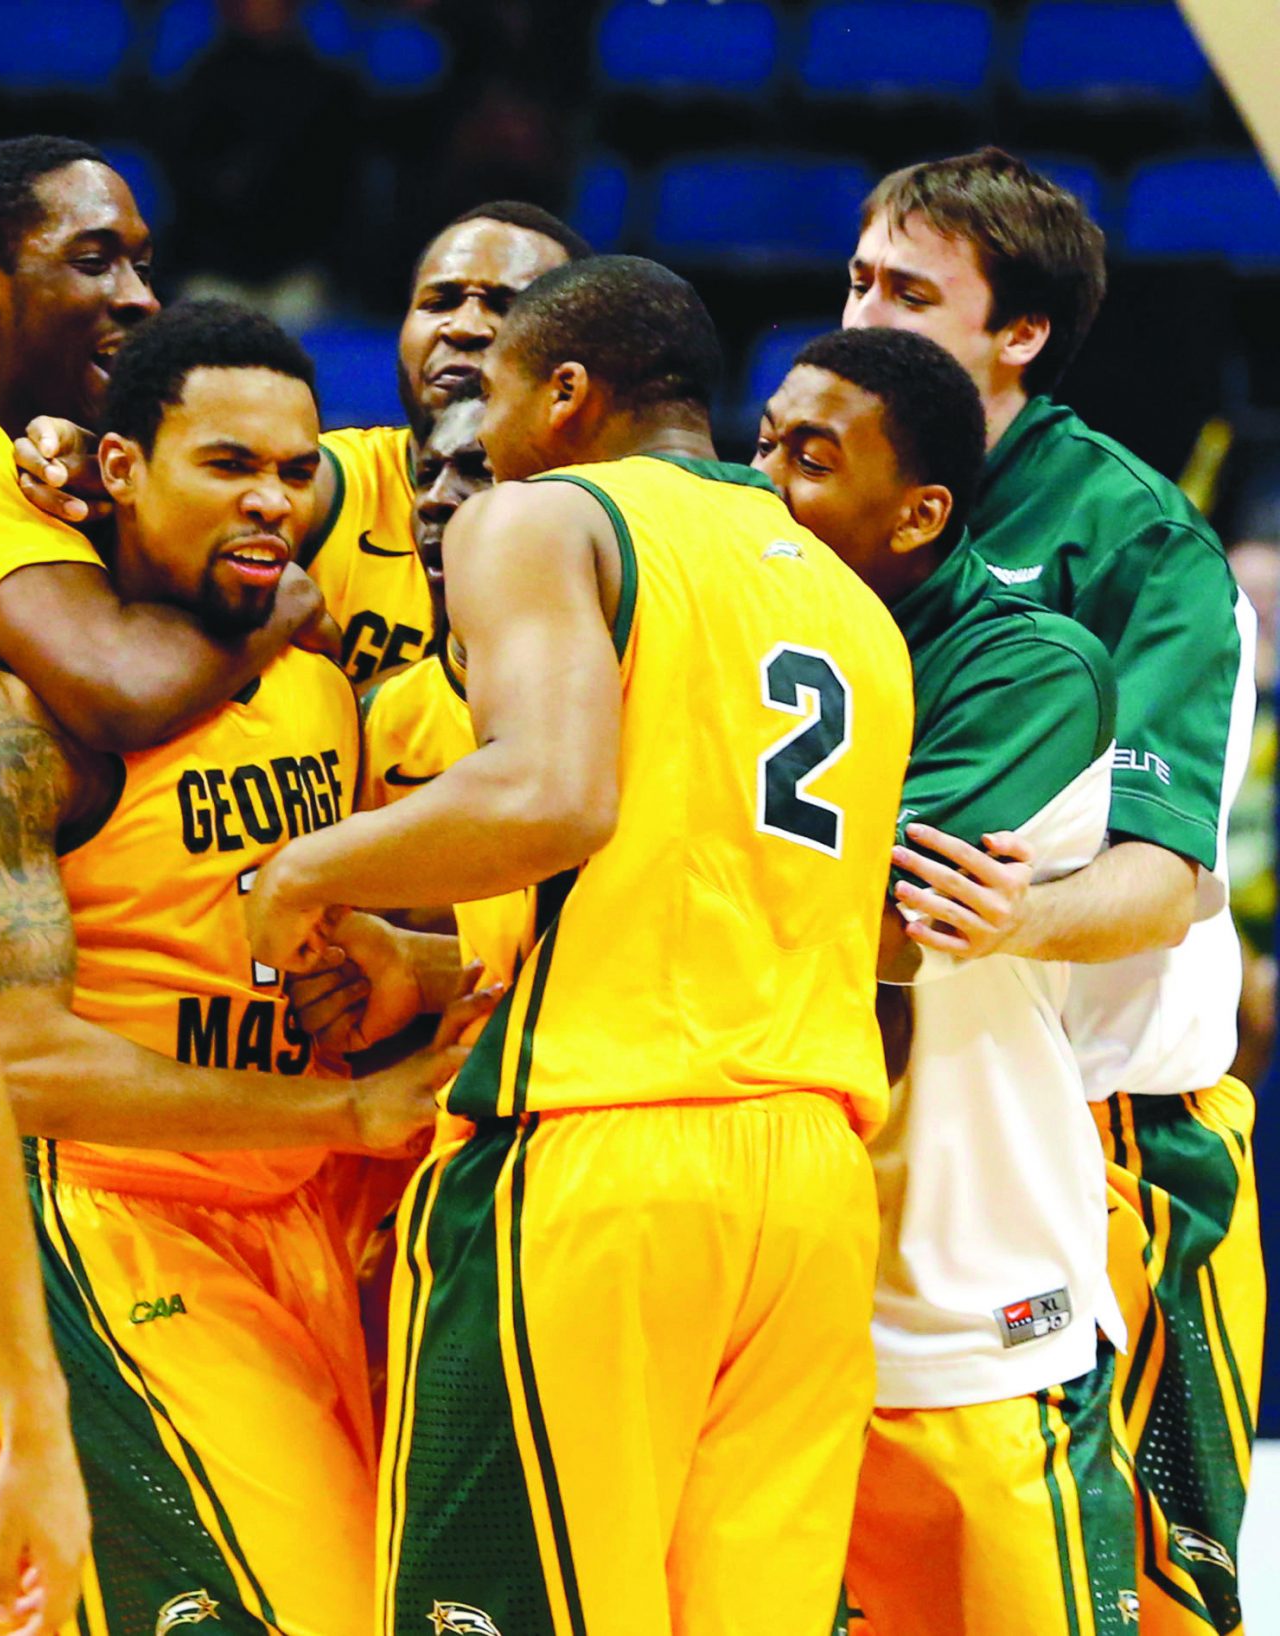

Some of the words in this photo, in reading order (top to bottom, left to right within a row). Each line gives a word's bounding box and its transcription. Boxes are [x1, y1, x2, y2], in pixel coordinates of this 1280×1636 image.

[177, 750, 342, 854] GEORGE
[756, 641, 854, 860] 2
[130, 1292, 188, 1325] CAA
